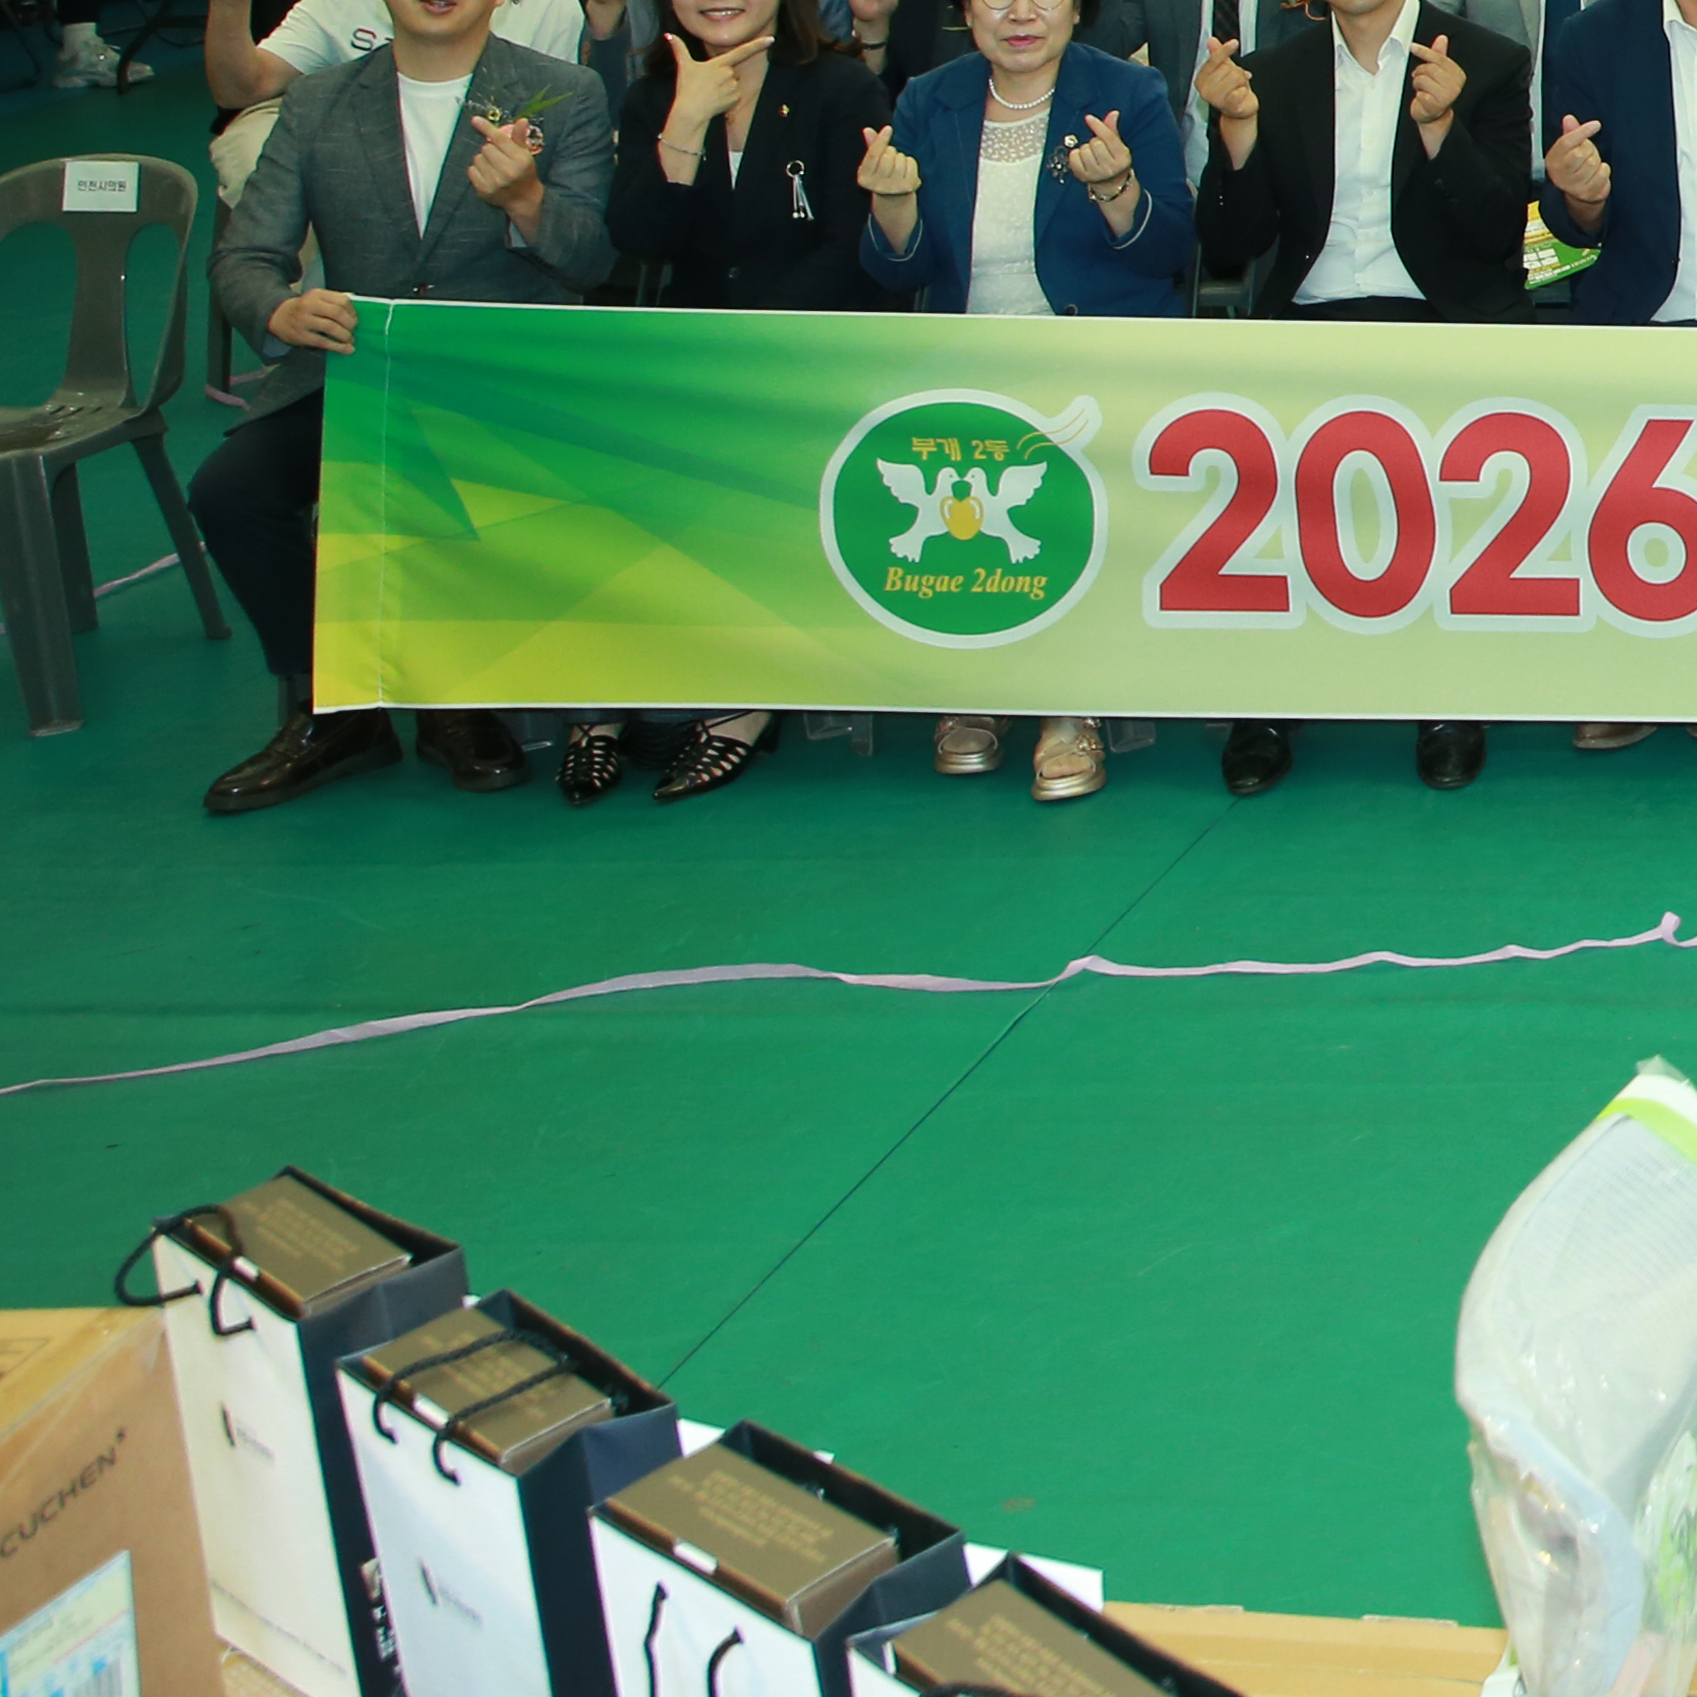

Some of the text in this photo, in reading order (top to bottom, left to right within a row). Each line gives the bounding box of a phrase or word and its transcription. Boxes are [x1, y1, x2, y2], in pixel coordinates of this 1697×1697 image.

[77, 179, 127, 193] 인천시의원
[911, 436, 1011, 462] 부개 2동
[884, 566, 1049, 601] Bugae 2dong
